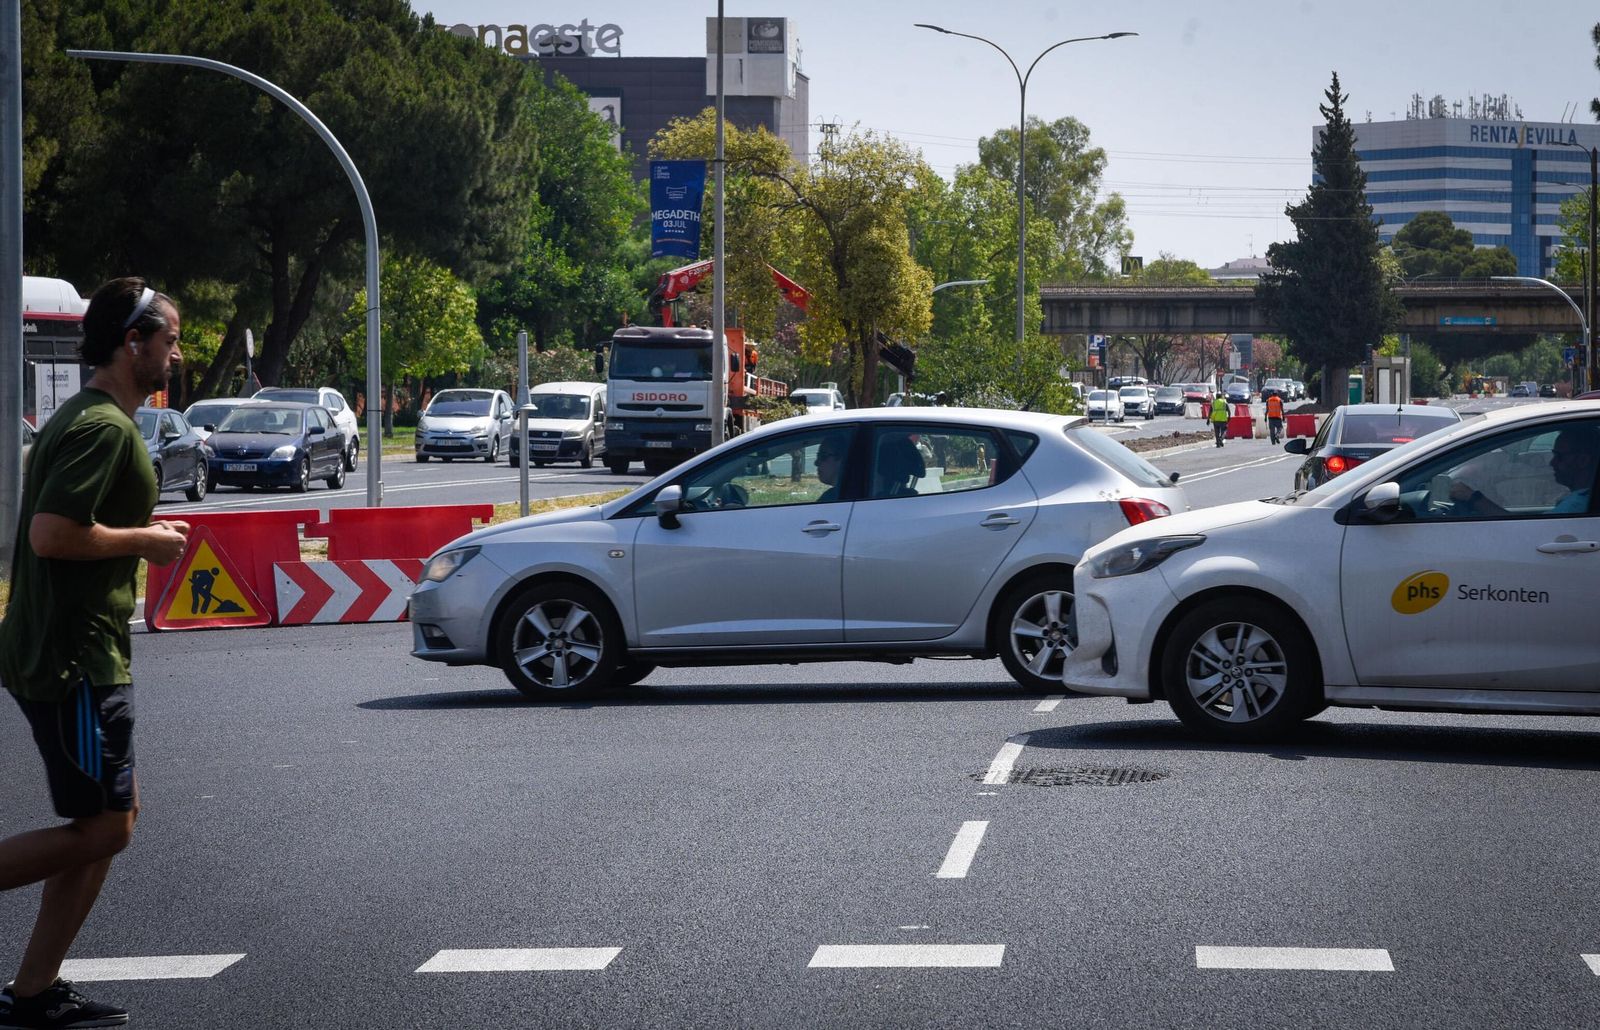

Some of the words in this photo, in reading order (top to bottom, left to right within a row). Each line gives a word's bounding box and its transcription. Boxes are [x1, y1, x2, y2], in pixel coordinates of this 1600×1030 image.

[1470, 125, 1518, 143] RENTA
[651, 209, 700, 222] MEGADETH
[632, 393, 688, 402] ISIDORO
[1407, 582, 1441, 601] phs
[1457, 584, 1550, 604] Serkonten
